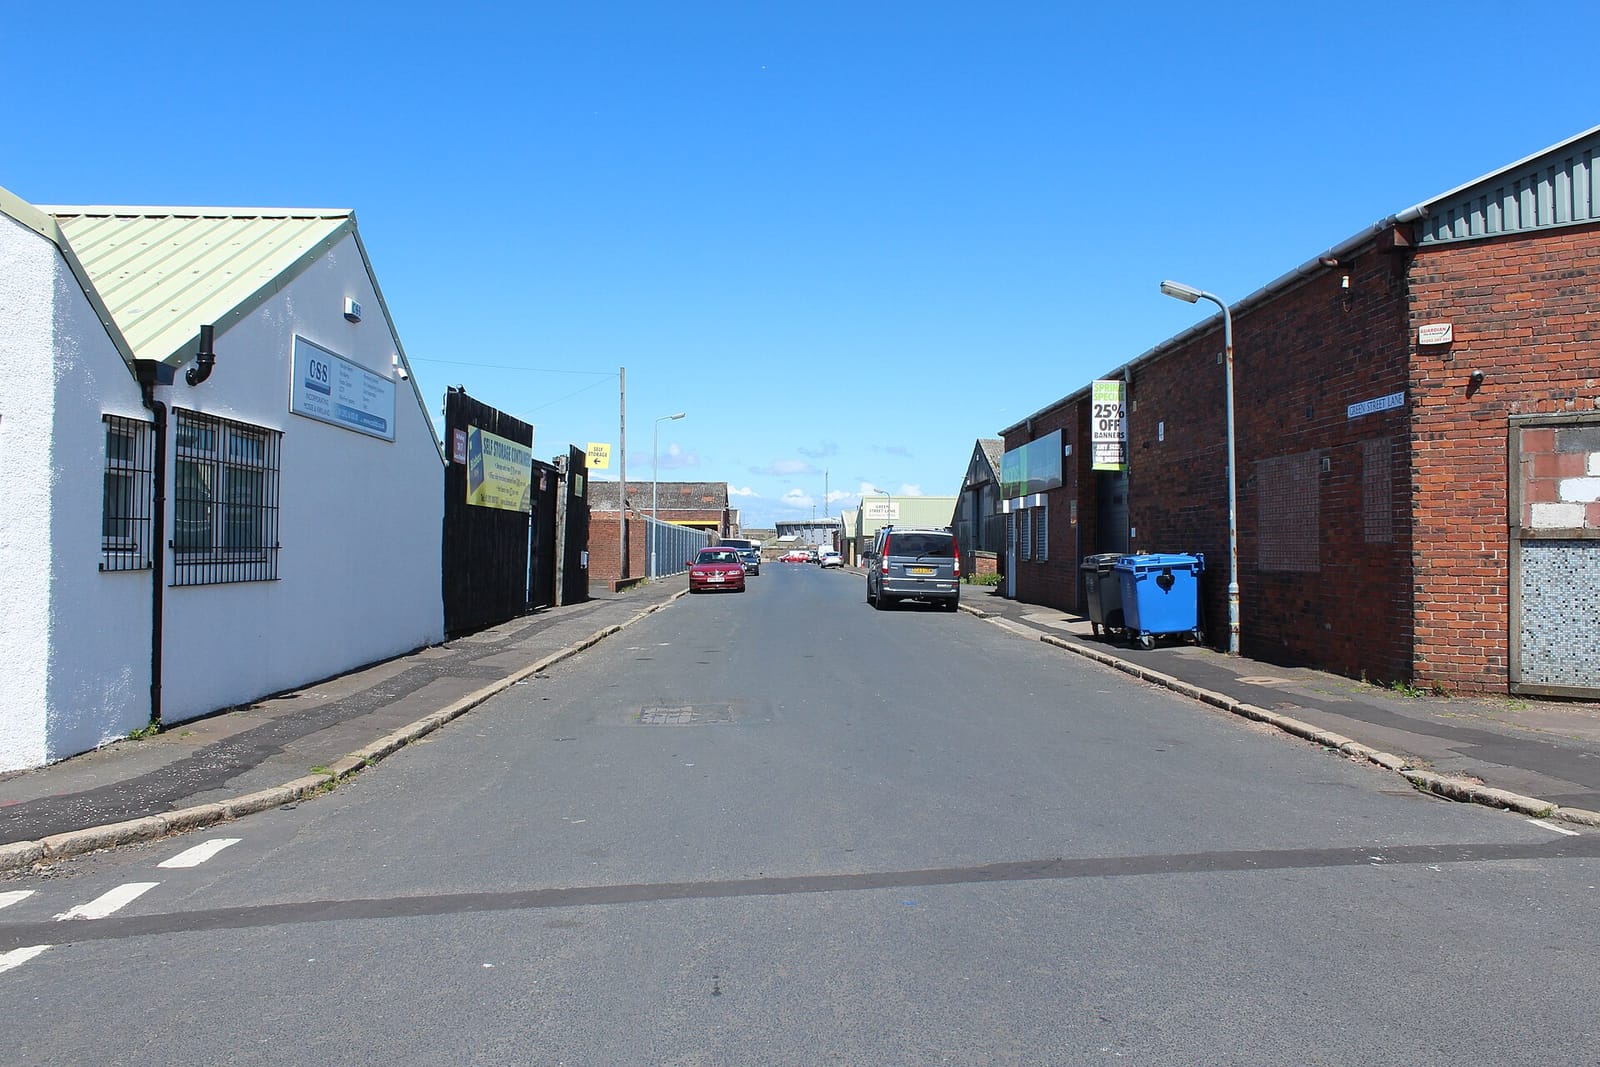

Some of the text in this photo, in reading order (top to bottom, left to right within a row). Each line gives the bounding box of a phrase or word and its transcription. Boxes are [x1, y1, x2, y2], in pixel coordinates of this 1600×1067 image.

[1094, 383, 1125, 392] SPRING
[1094, 392, 1125, 401] SPECIAL
[1351, 393, 1403, 415] GREEN STREET LANE
[1094, 404, 1125, 418] 25%
[1099, 419, 1120, 431] OFF
[1094, 431, 1125, 439] BANNERS
[483, 437, 493, 456] SELF
[493, 440, 512, 462] STORAGE
